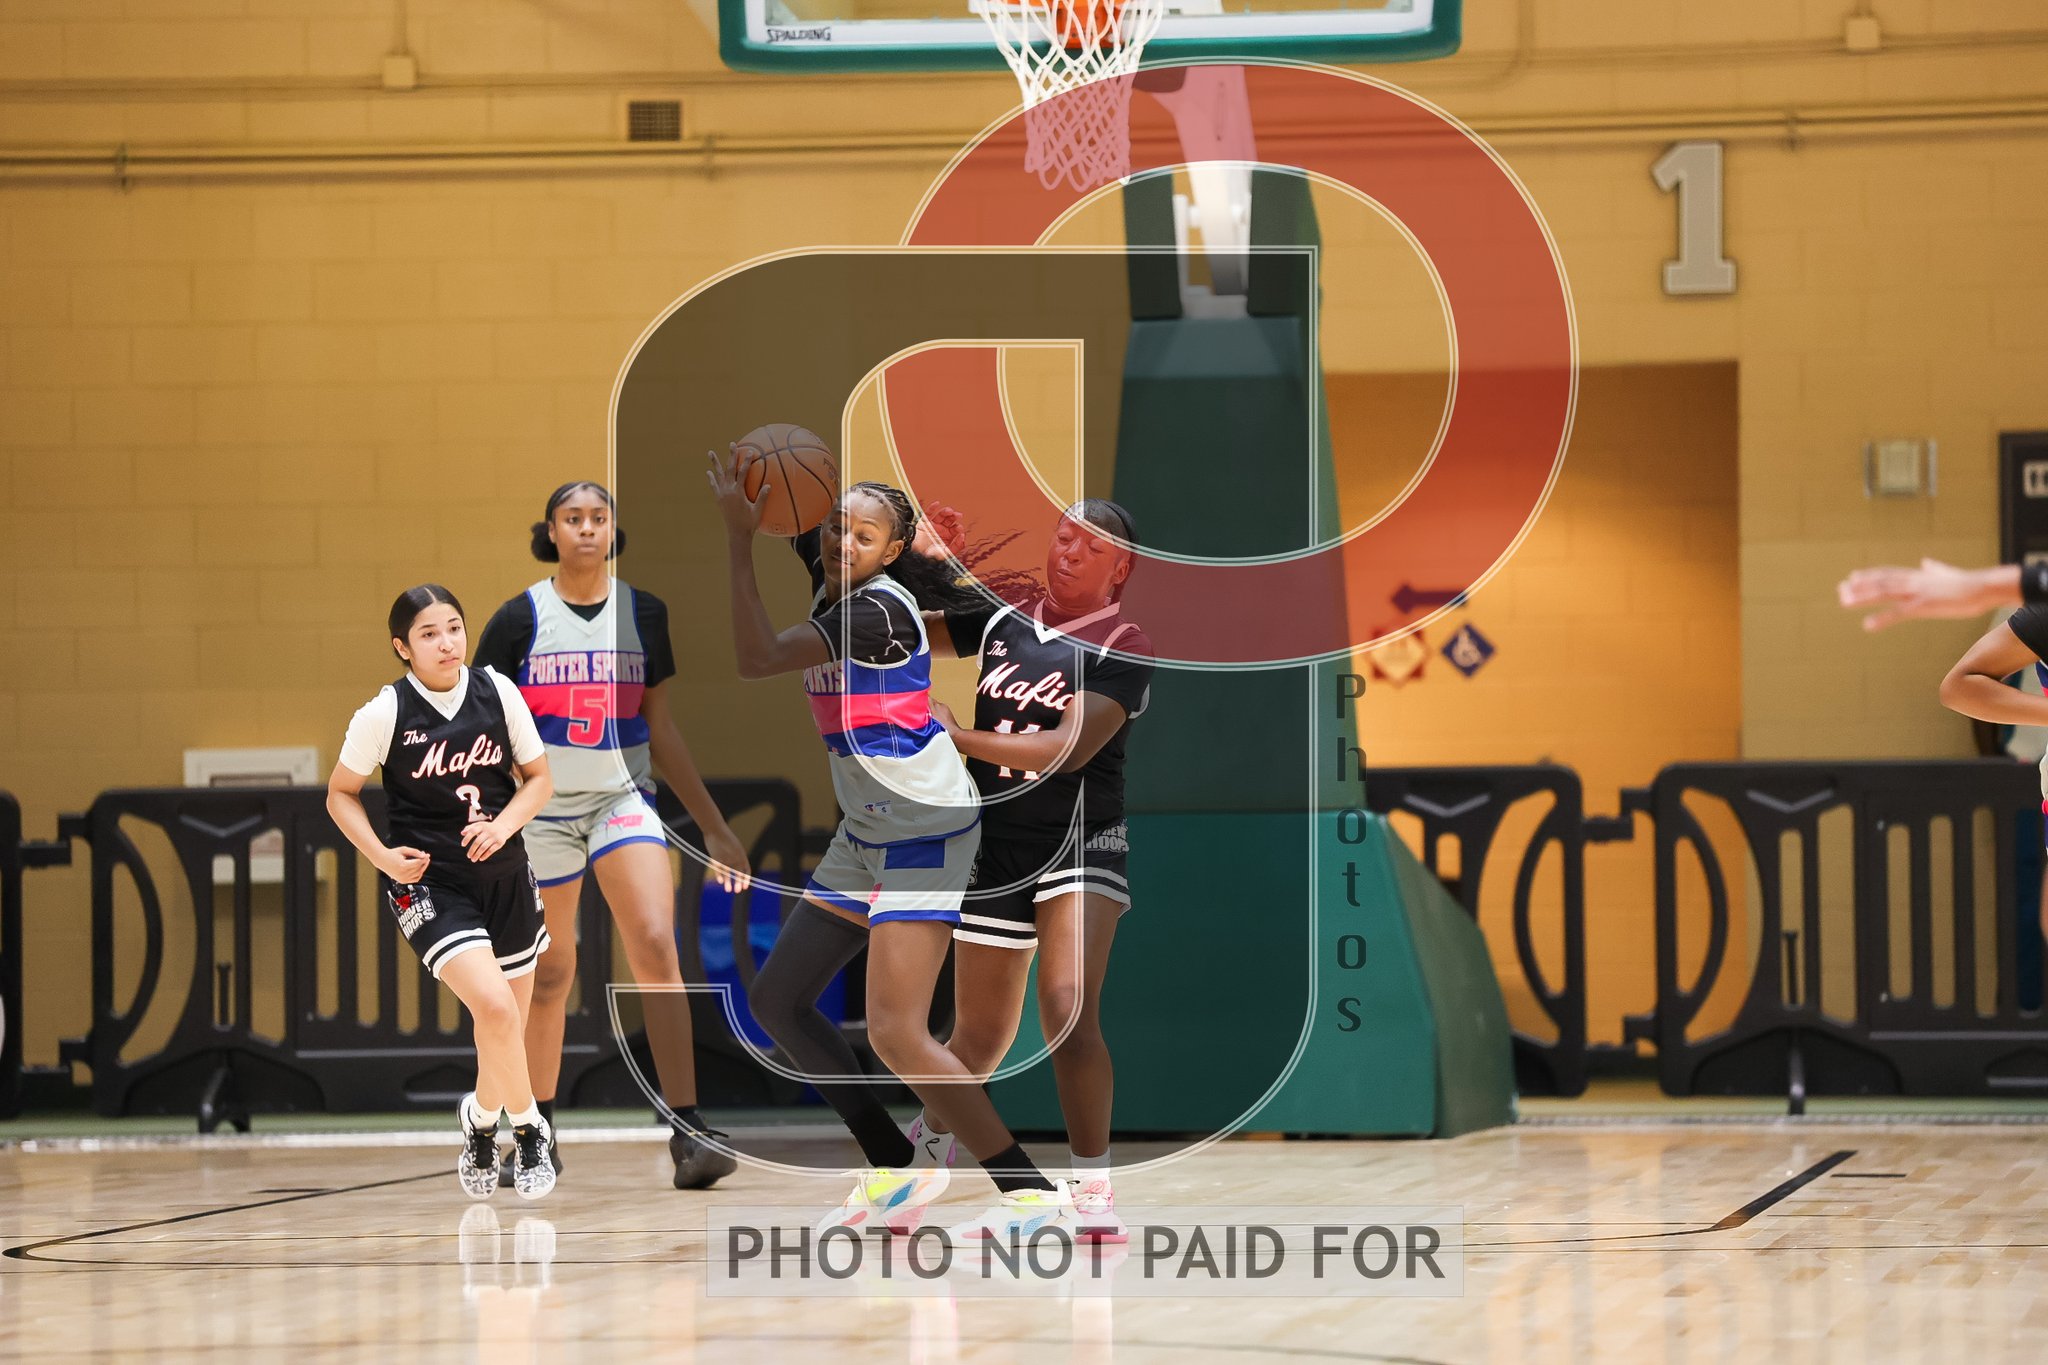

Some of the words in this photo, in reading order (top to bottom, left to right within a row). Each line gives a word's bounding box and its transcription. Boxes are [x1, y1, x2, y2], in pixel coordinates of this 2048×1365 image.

[766, 27, 831, 43] SPALDING
[1651, 140, 1737, 294] 1
[986, 640, 1007, 656] The
[528, 653, 589, 685] PORTER
[592, 652, 645, 683] SPORTS
[567, 685, 608, 748] 5
[403, 730, 428, 746] The
[412, 734, 503, 778] Mafia
[456, 784, 492, 822] 2
